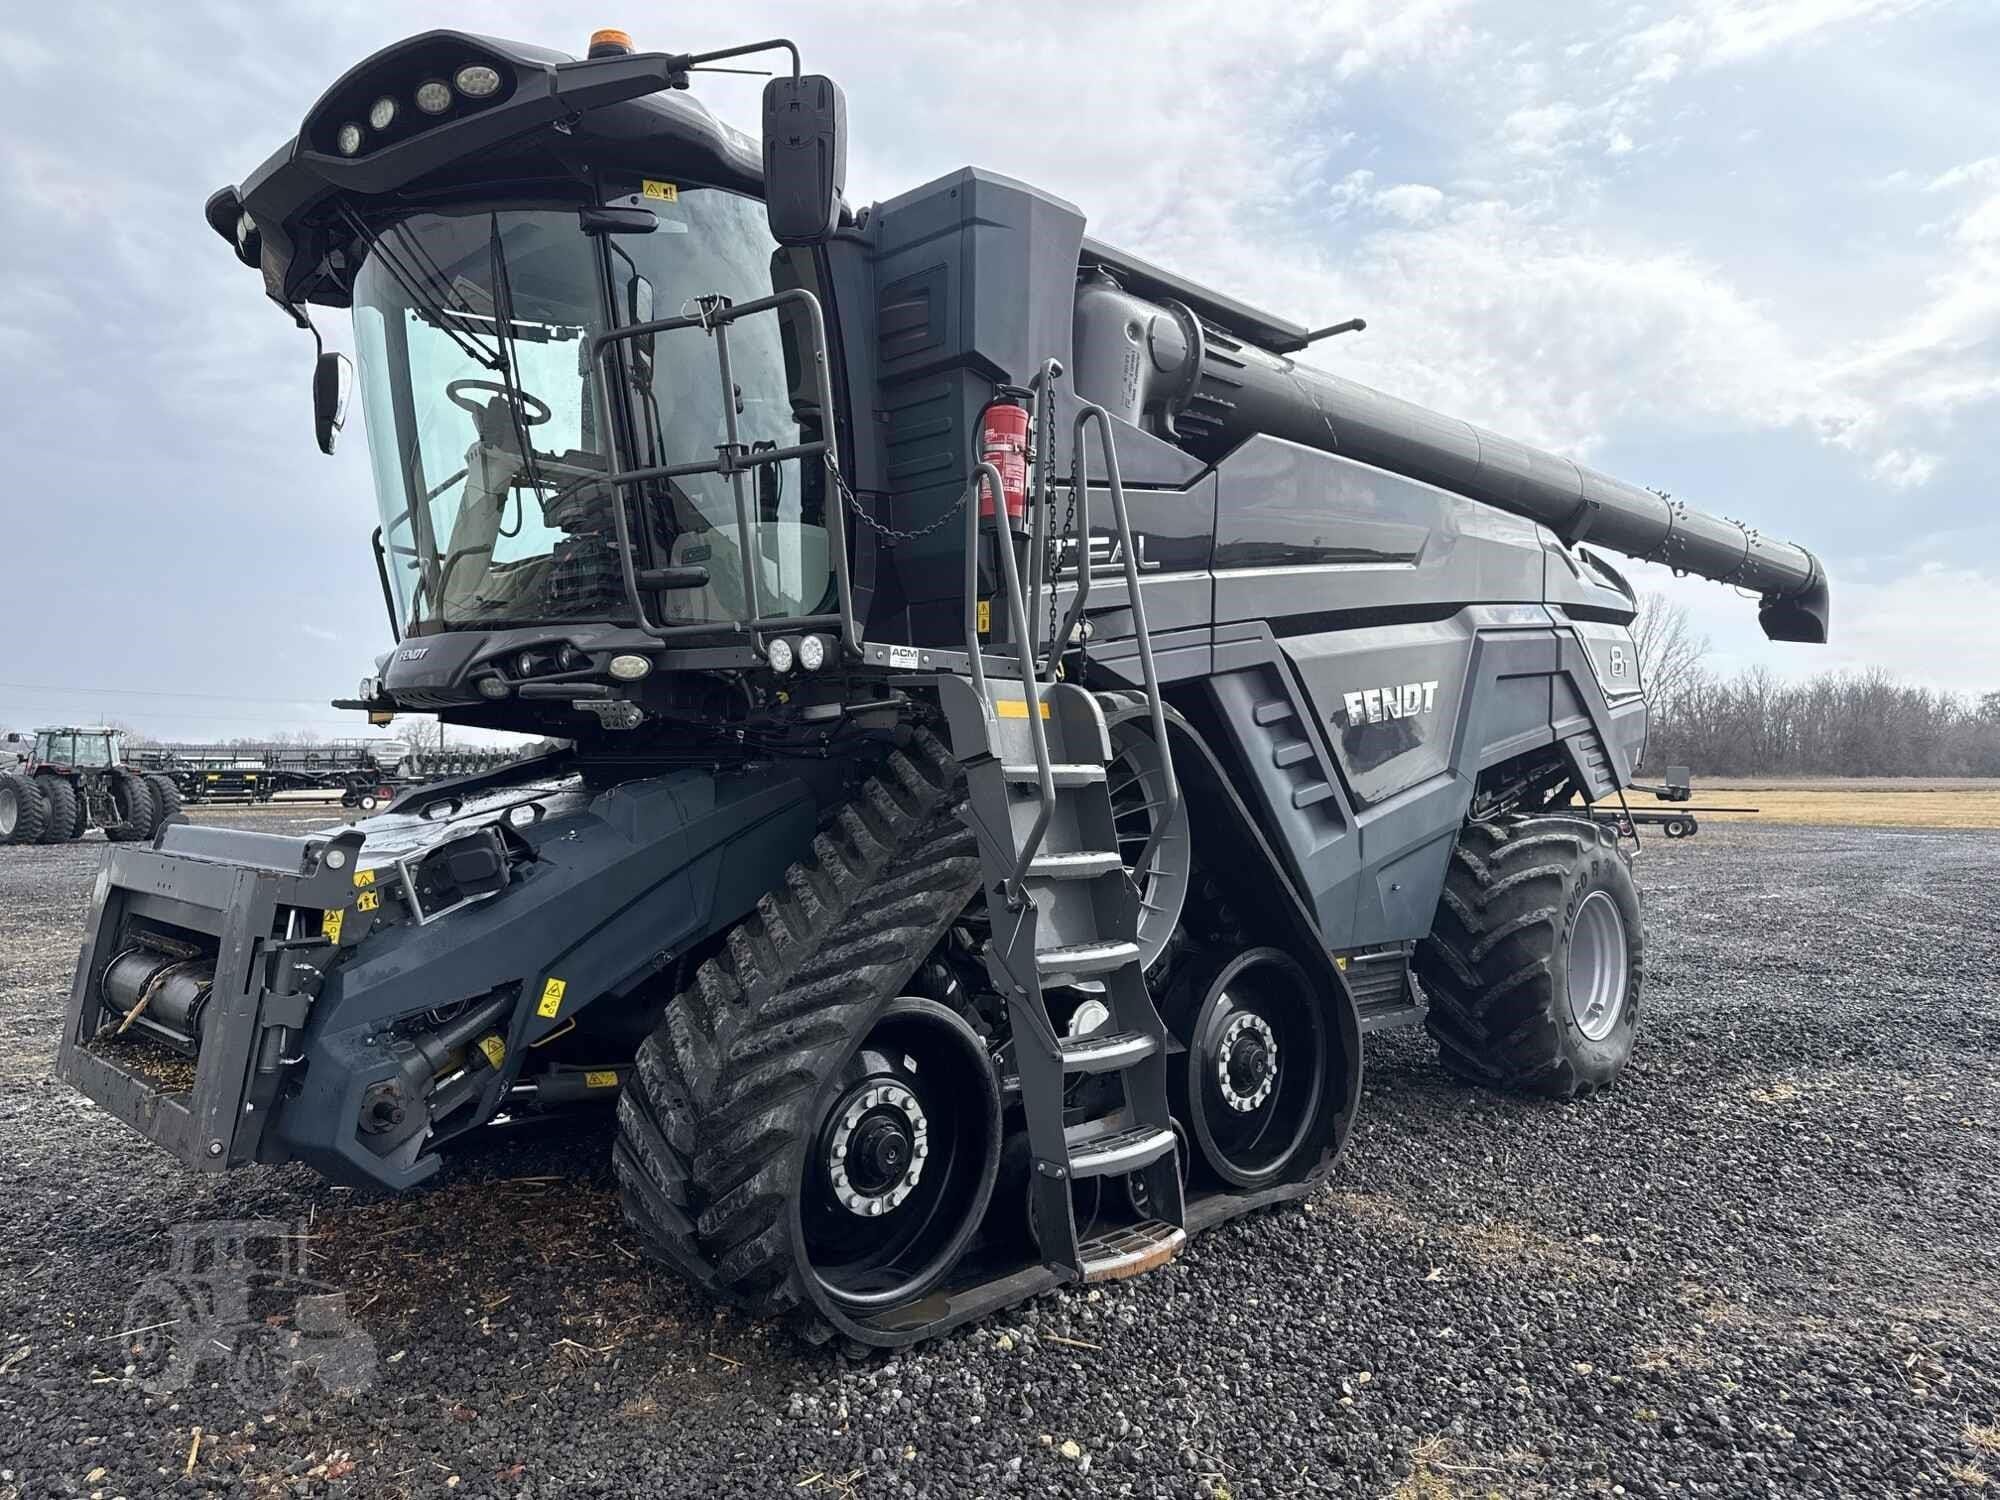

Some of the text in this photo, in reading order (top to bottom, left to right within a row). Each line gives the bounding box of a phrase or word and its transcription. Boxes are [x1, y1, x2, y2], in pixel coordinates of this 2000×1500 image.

[399, 648, 429, 661] FENDT
[892, 648, 918, 657] ACM
[1343, 680, 1439, 727] FENDT
